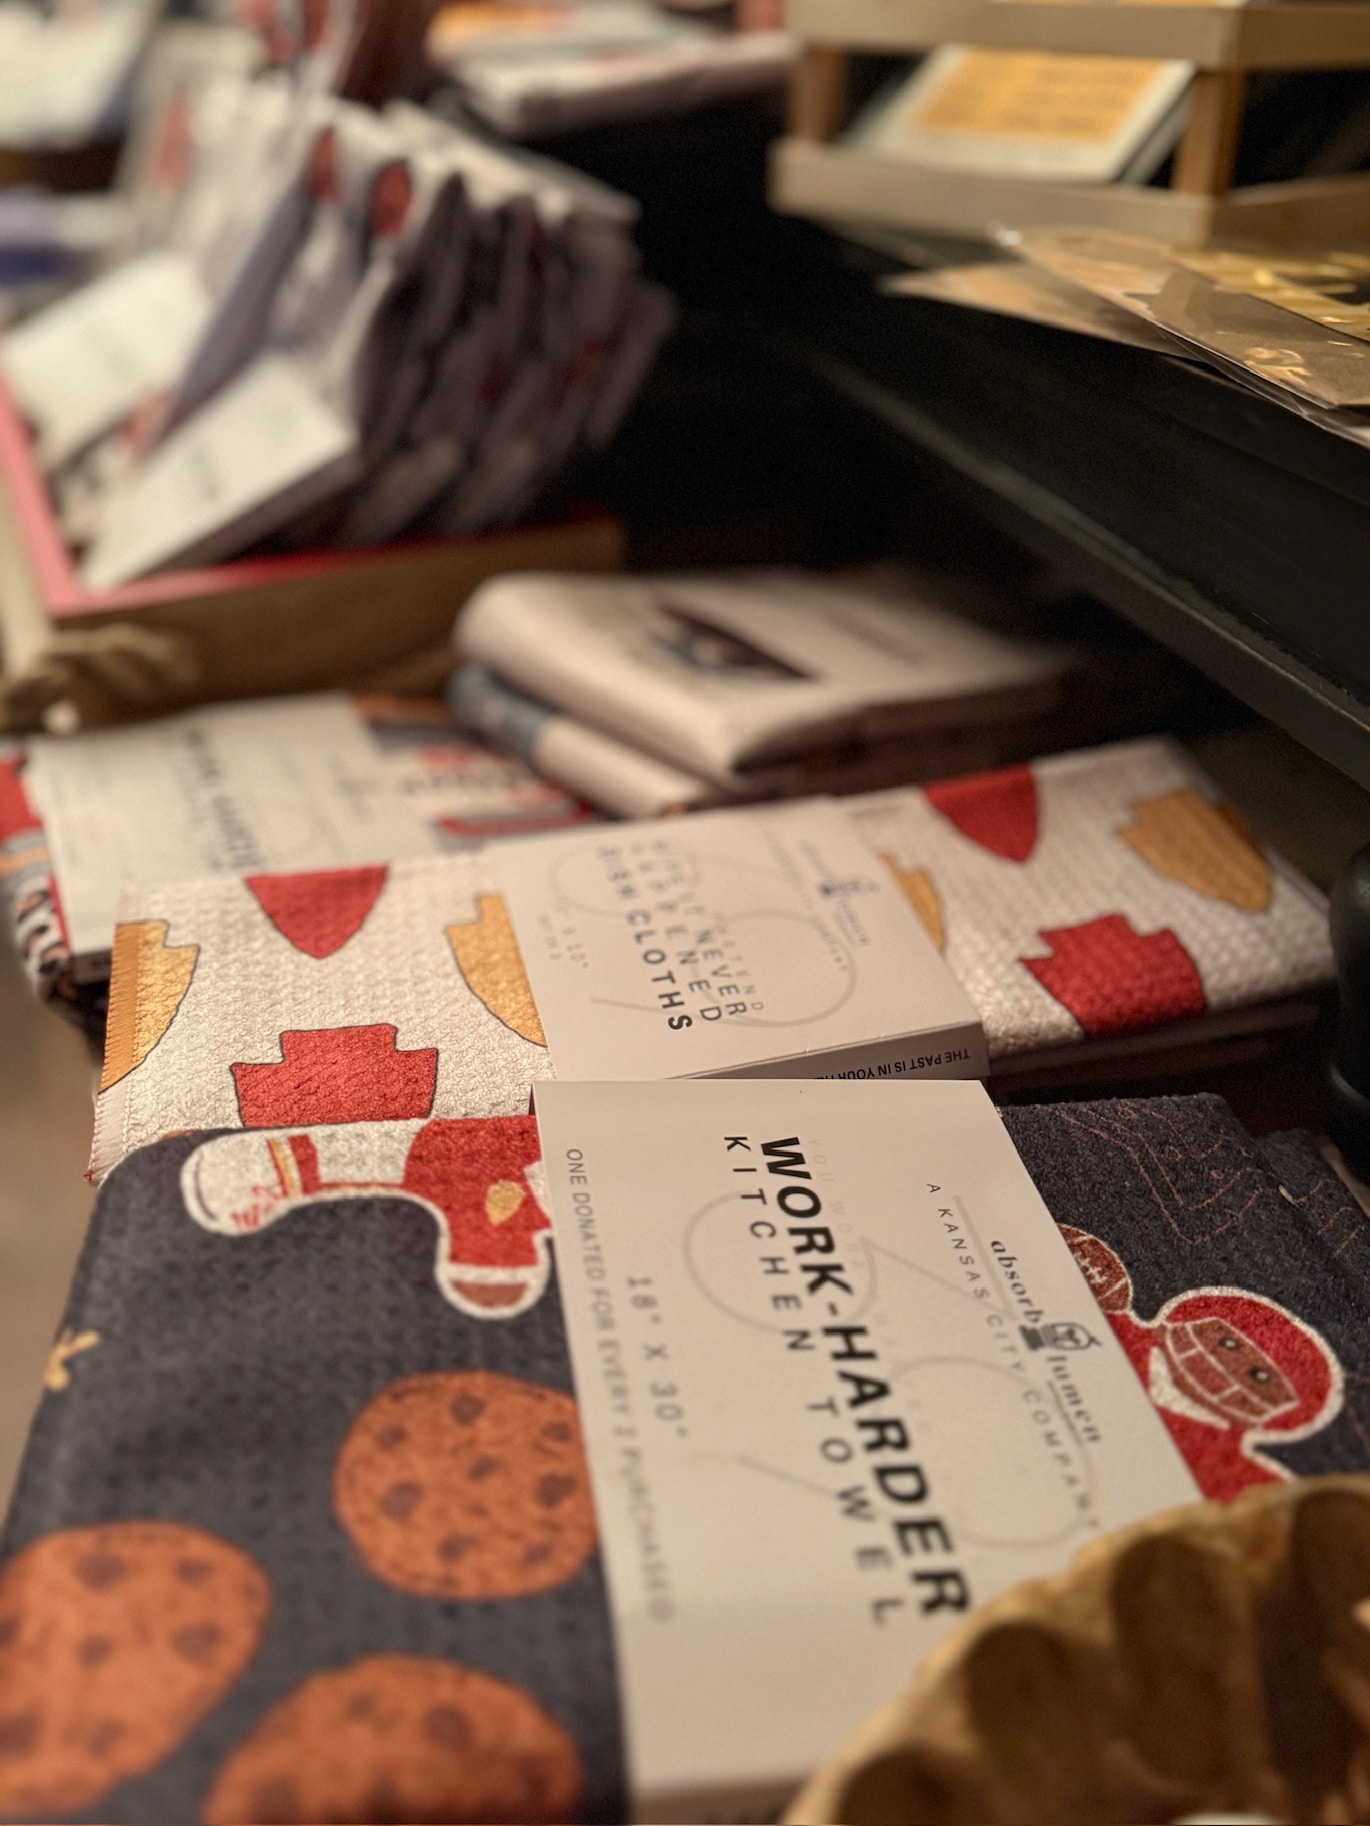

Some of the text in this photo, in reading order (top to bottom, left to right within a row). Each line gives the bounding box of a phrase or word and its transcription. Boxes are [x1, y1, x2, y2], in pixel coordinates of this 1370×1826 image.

[626, 909, 693, 1031] CLOTHS
[695, 928, 748, 1016] NEVER
[878, 1064, 892, 1077] IN
[894, 1060, 907, 1073] IS
[909, 1054, 942, 1071] PAST
[945, 1048, 971, 1064] THE
[566, 1148, 588, 1186] ONE
[572, 1192, 606, 1281] DONATED
[591, 1286, 617, 1330] FOR
[926, 1183, 942, 1194] A
[937, 1208, 990, 1299] KANSAS
[987, 1313, 1026, 1371] CITY
[990, 1240, 1045, 1323] absorb
[650, 1382, 688, 1439] 30"
[723, 1135, 904, 1628] KITCHEN TOWEL
[760, 1135, 971, 1616] WORK-HARDER
